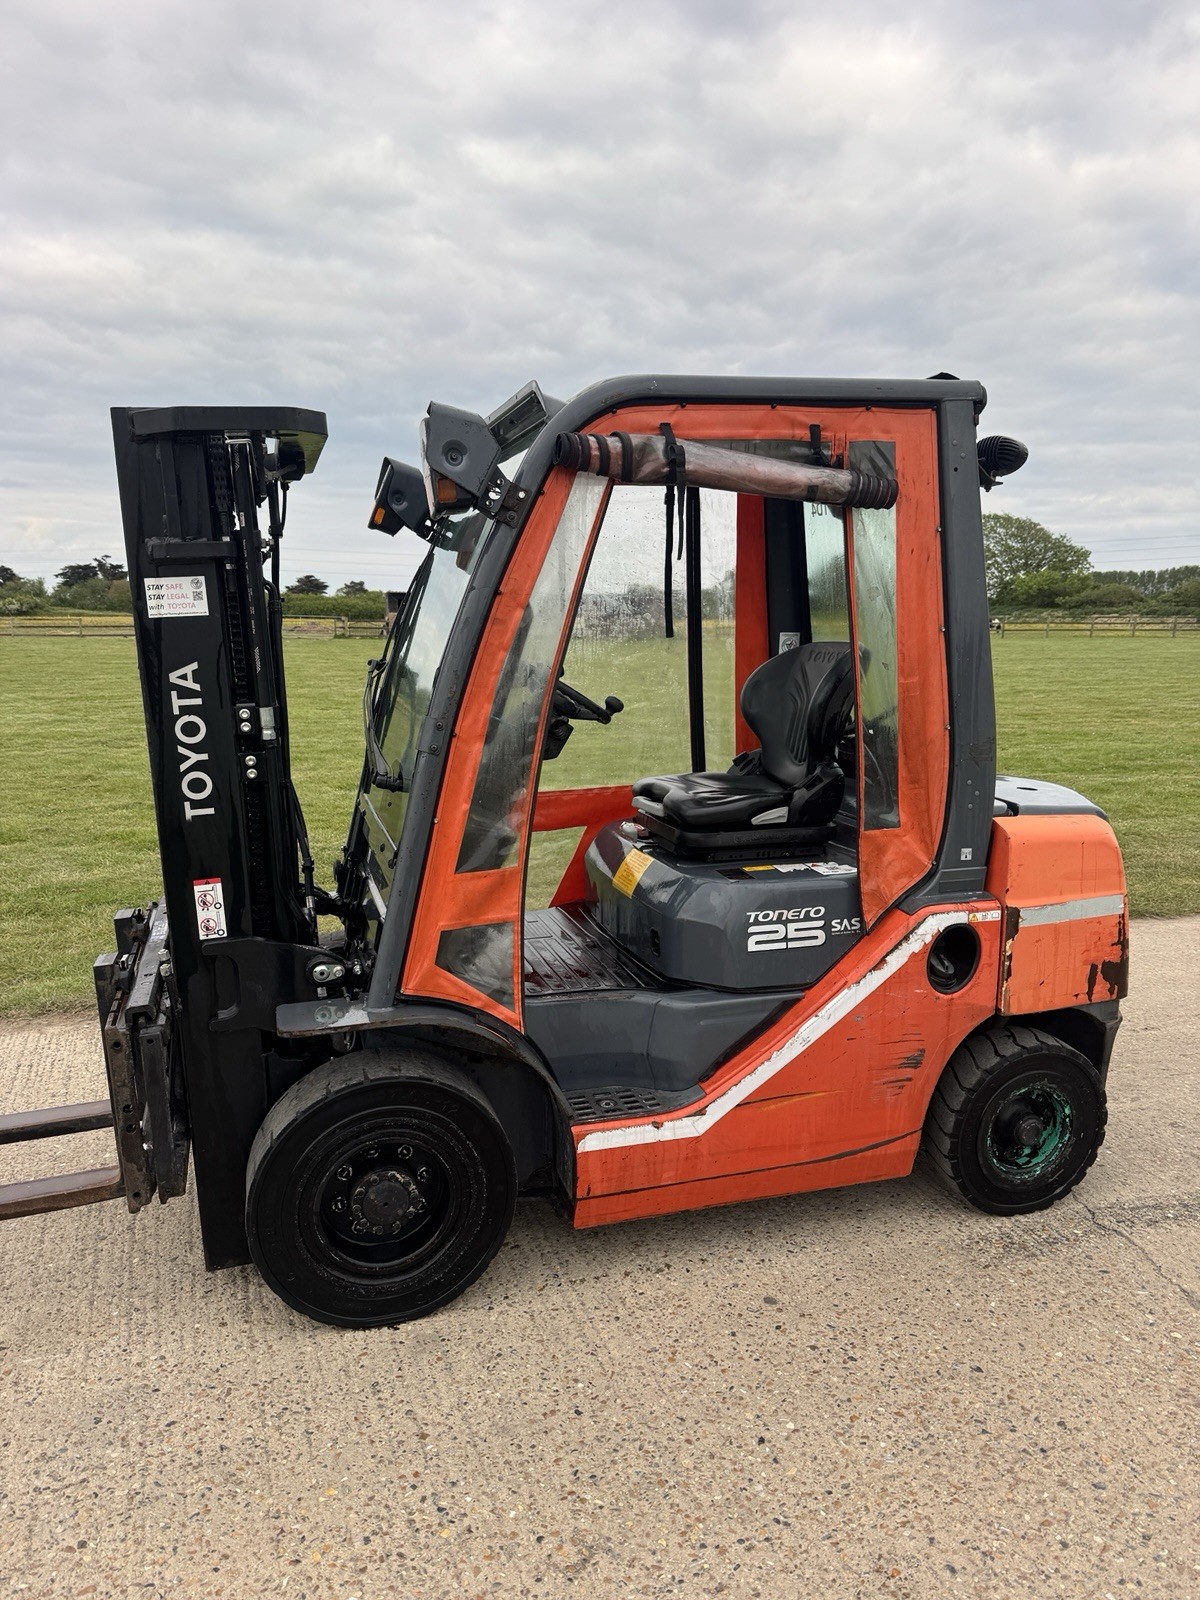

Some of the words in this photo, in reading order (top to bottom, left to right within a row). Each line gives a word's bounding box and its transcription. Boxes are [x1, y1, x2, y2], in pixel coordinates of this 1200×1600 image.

[168, 602, 196, 610] TOYOTA
[169, 661, 215, 821] TOYOTA
[746, 906, 825, 923] TONERO
[831, 918, 860, 931] SAS
[747, 920, 826, 952] 25
